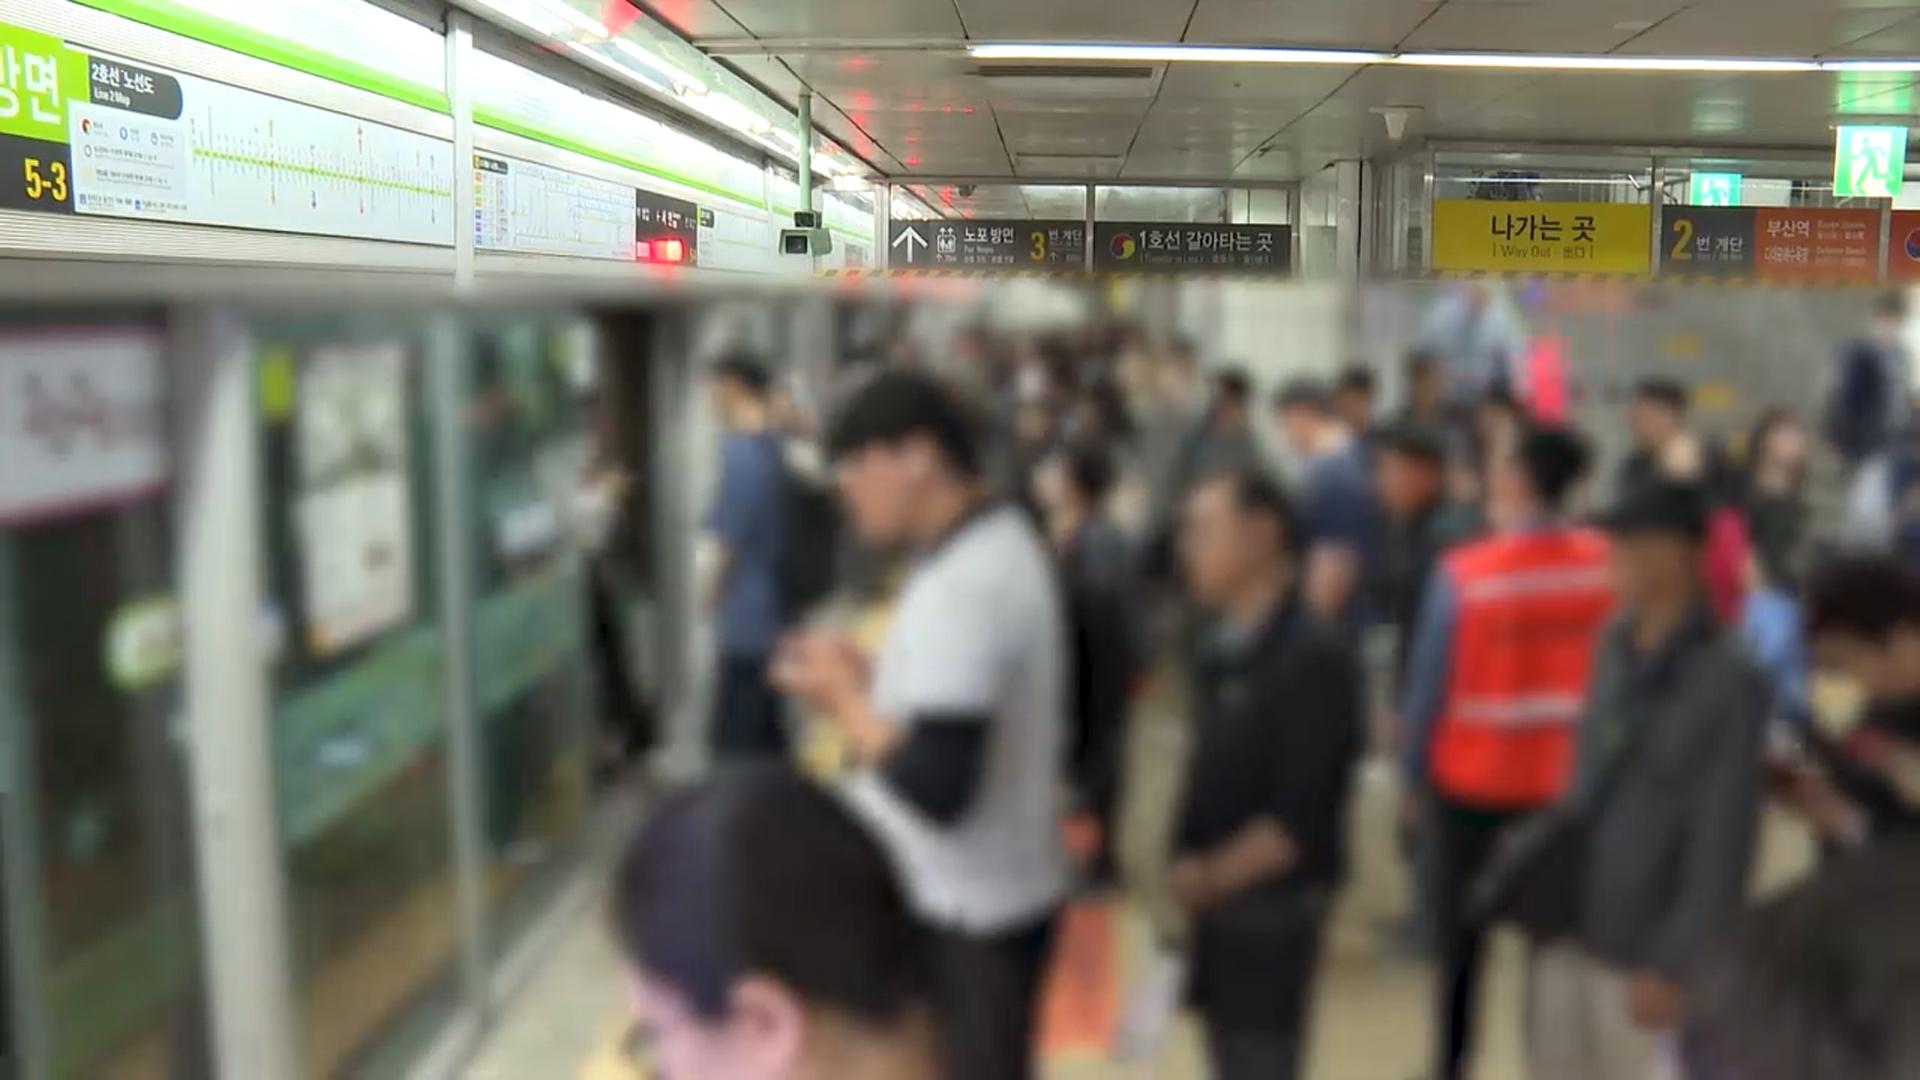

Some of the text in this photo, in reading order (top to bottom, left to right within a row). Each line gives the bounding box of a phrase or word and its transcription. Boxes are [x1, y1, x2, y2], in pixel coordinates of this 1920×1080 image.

[91, 63, 155, 94] 2호선 노선도
[24, 157, 68, 201] 5-3
[964, 226, 989, 243] 노포
[1139, 230, 1273, 252] 1호선 갈아타는 곳
[1491, 214, 1596, 242] 나가는 곳
[1671, 218, 1694, 261] 2
[1696, 236, 1711, 252] 번
[1716, 236, 1743, 253] 계단
[1767, 219, 1810, 239] 부산역
[1030, 231, 1045, 260] 3
[1501, 245, 1528, 259] Way
[1531, 245, 1551, 258] Out
